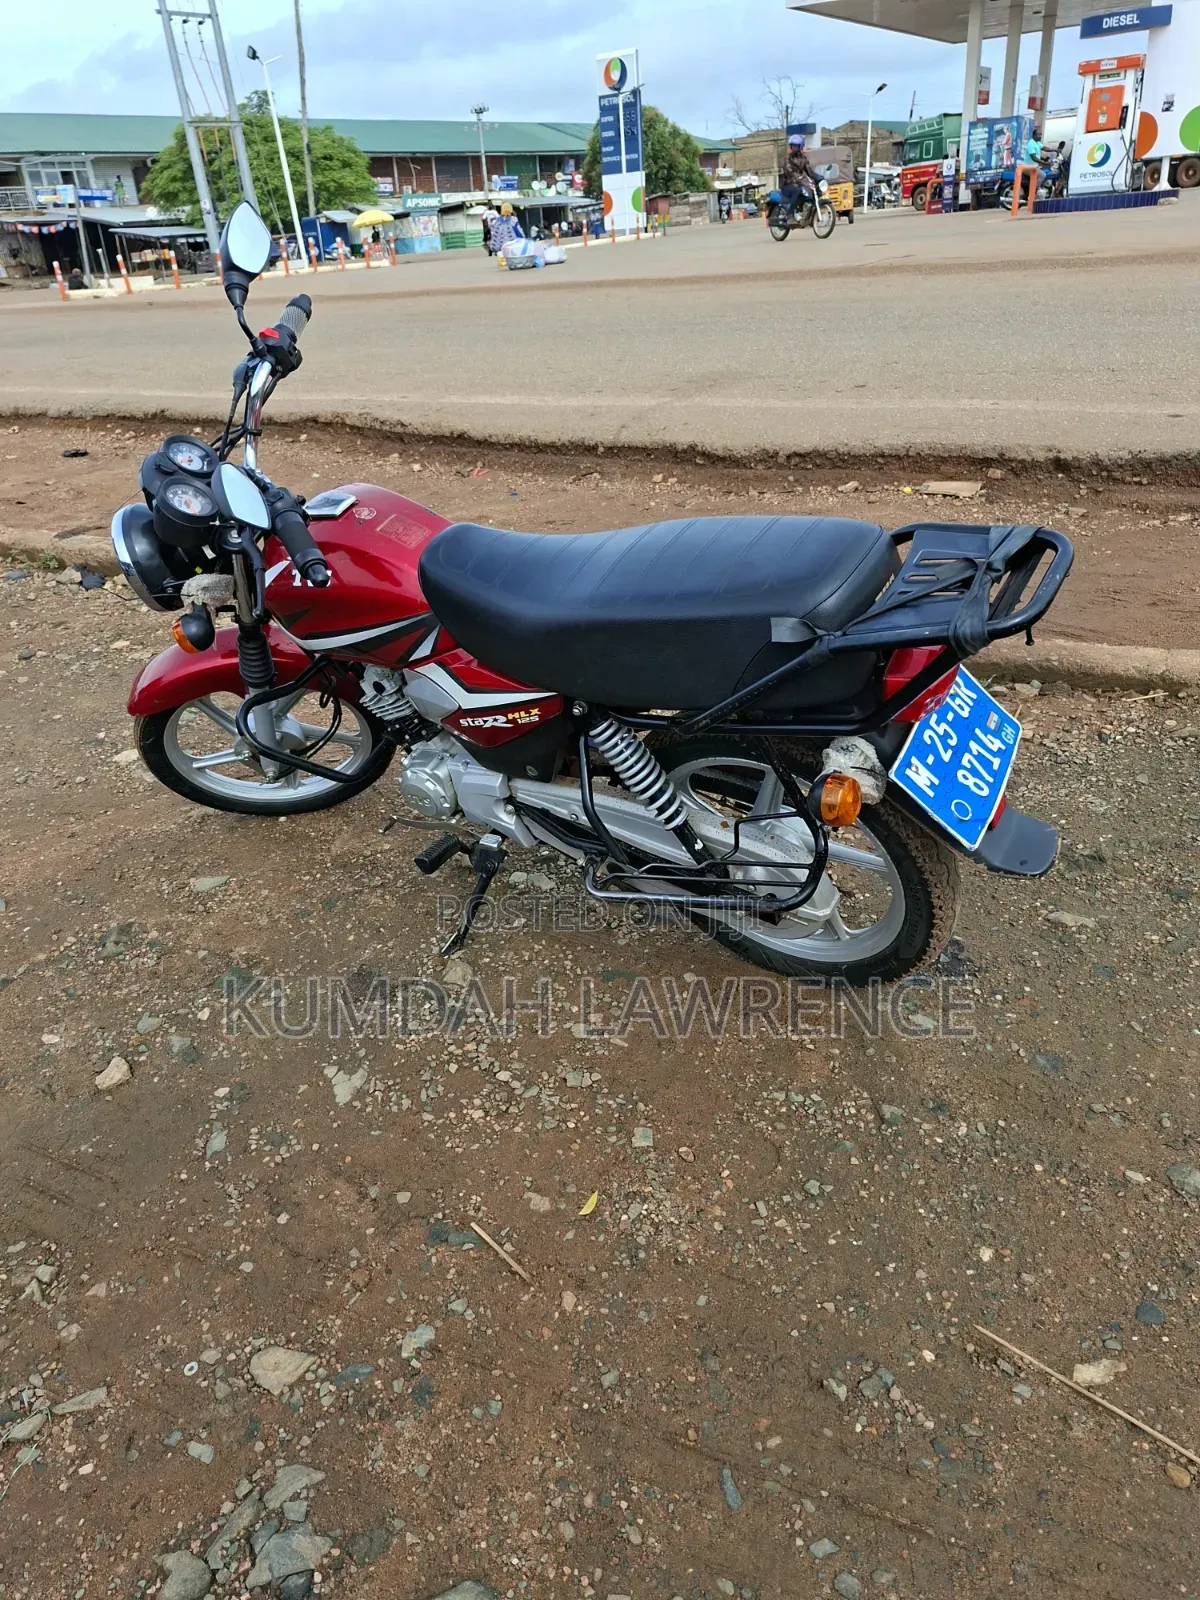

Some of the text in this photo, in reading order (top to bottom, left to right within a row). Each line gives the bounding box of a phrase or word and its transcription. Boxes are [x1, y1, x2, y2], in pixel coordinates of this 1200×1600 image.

[1102, 13, 1140, 28] DIESEL
[600, 95, 635, 106] PETRSOL
[1079, 170, 1114, 179] PETROSOL
[406, 197, 442, 208] APSONIC
[508, 708, 541, 719] HLX
[516, 716, 540, 725] 125
[1001, 723, 1016, 744] GH
[956, 727, 1006, 797] 8714
